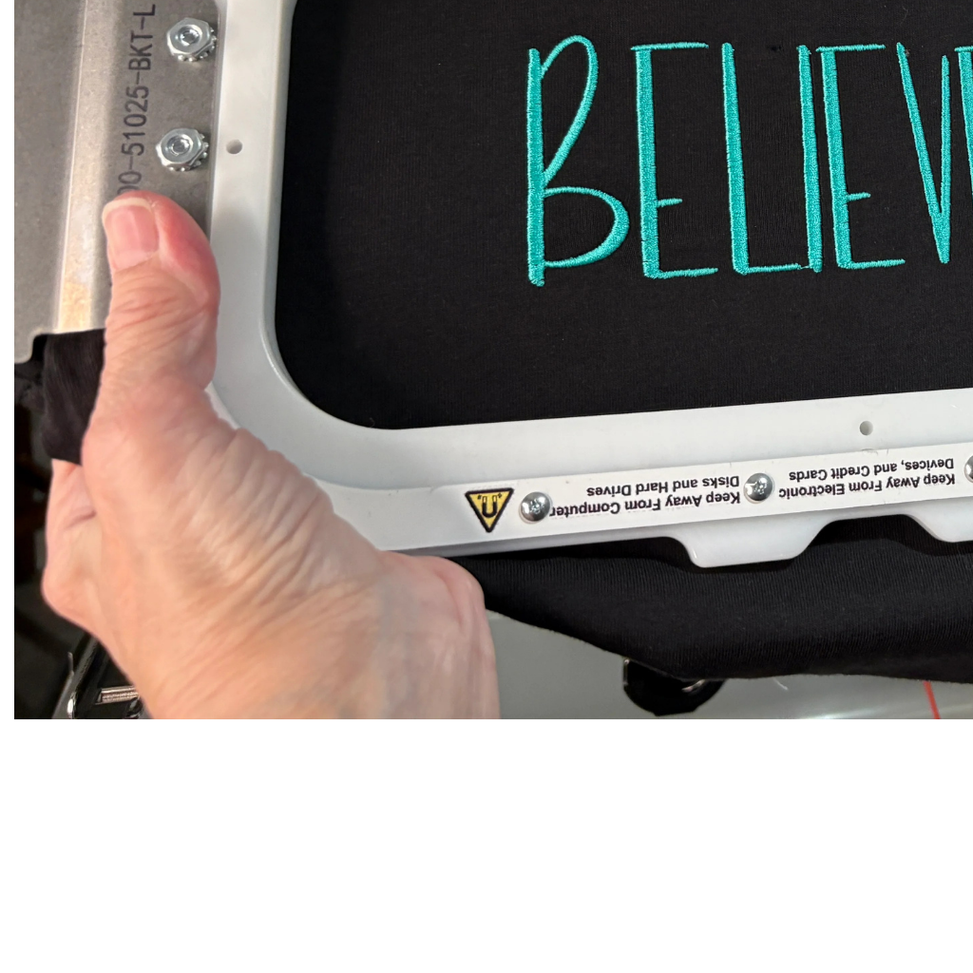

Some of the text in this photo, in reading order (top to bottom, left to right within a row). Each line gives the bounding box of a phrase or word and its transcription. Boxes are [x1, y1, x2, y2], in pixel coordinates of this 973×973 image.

[788, 458, 955, 482] Devices, and Credit Cards
[586, 475, 740, 497] Disks and Hard Drives
[778, 473, 956, 500] Keep Away From Electronic
[550, 491, 741, 518] Keep Away From Computer
